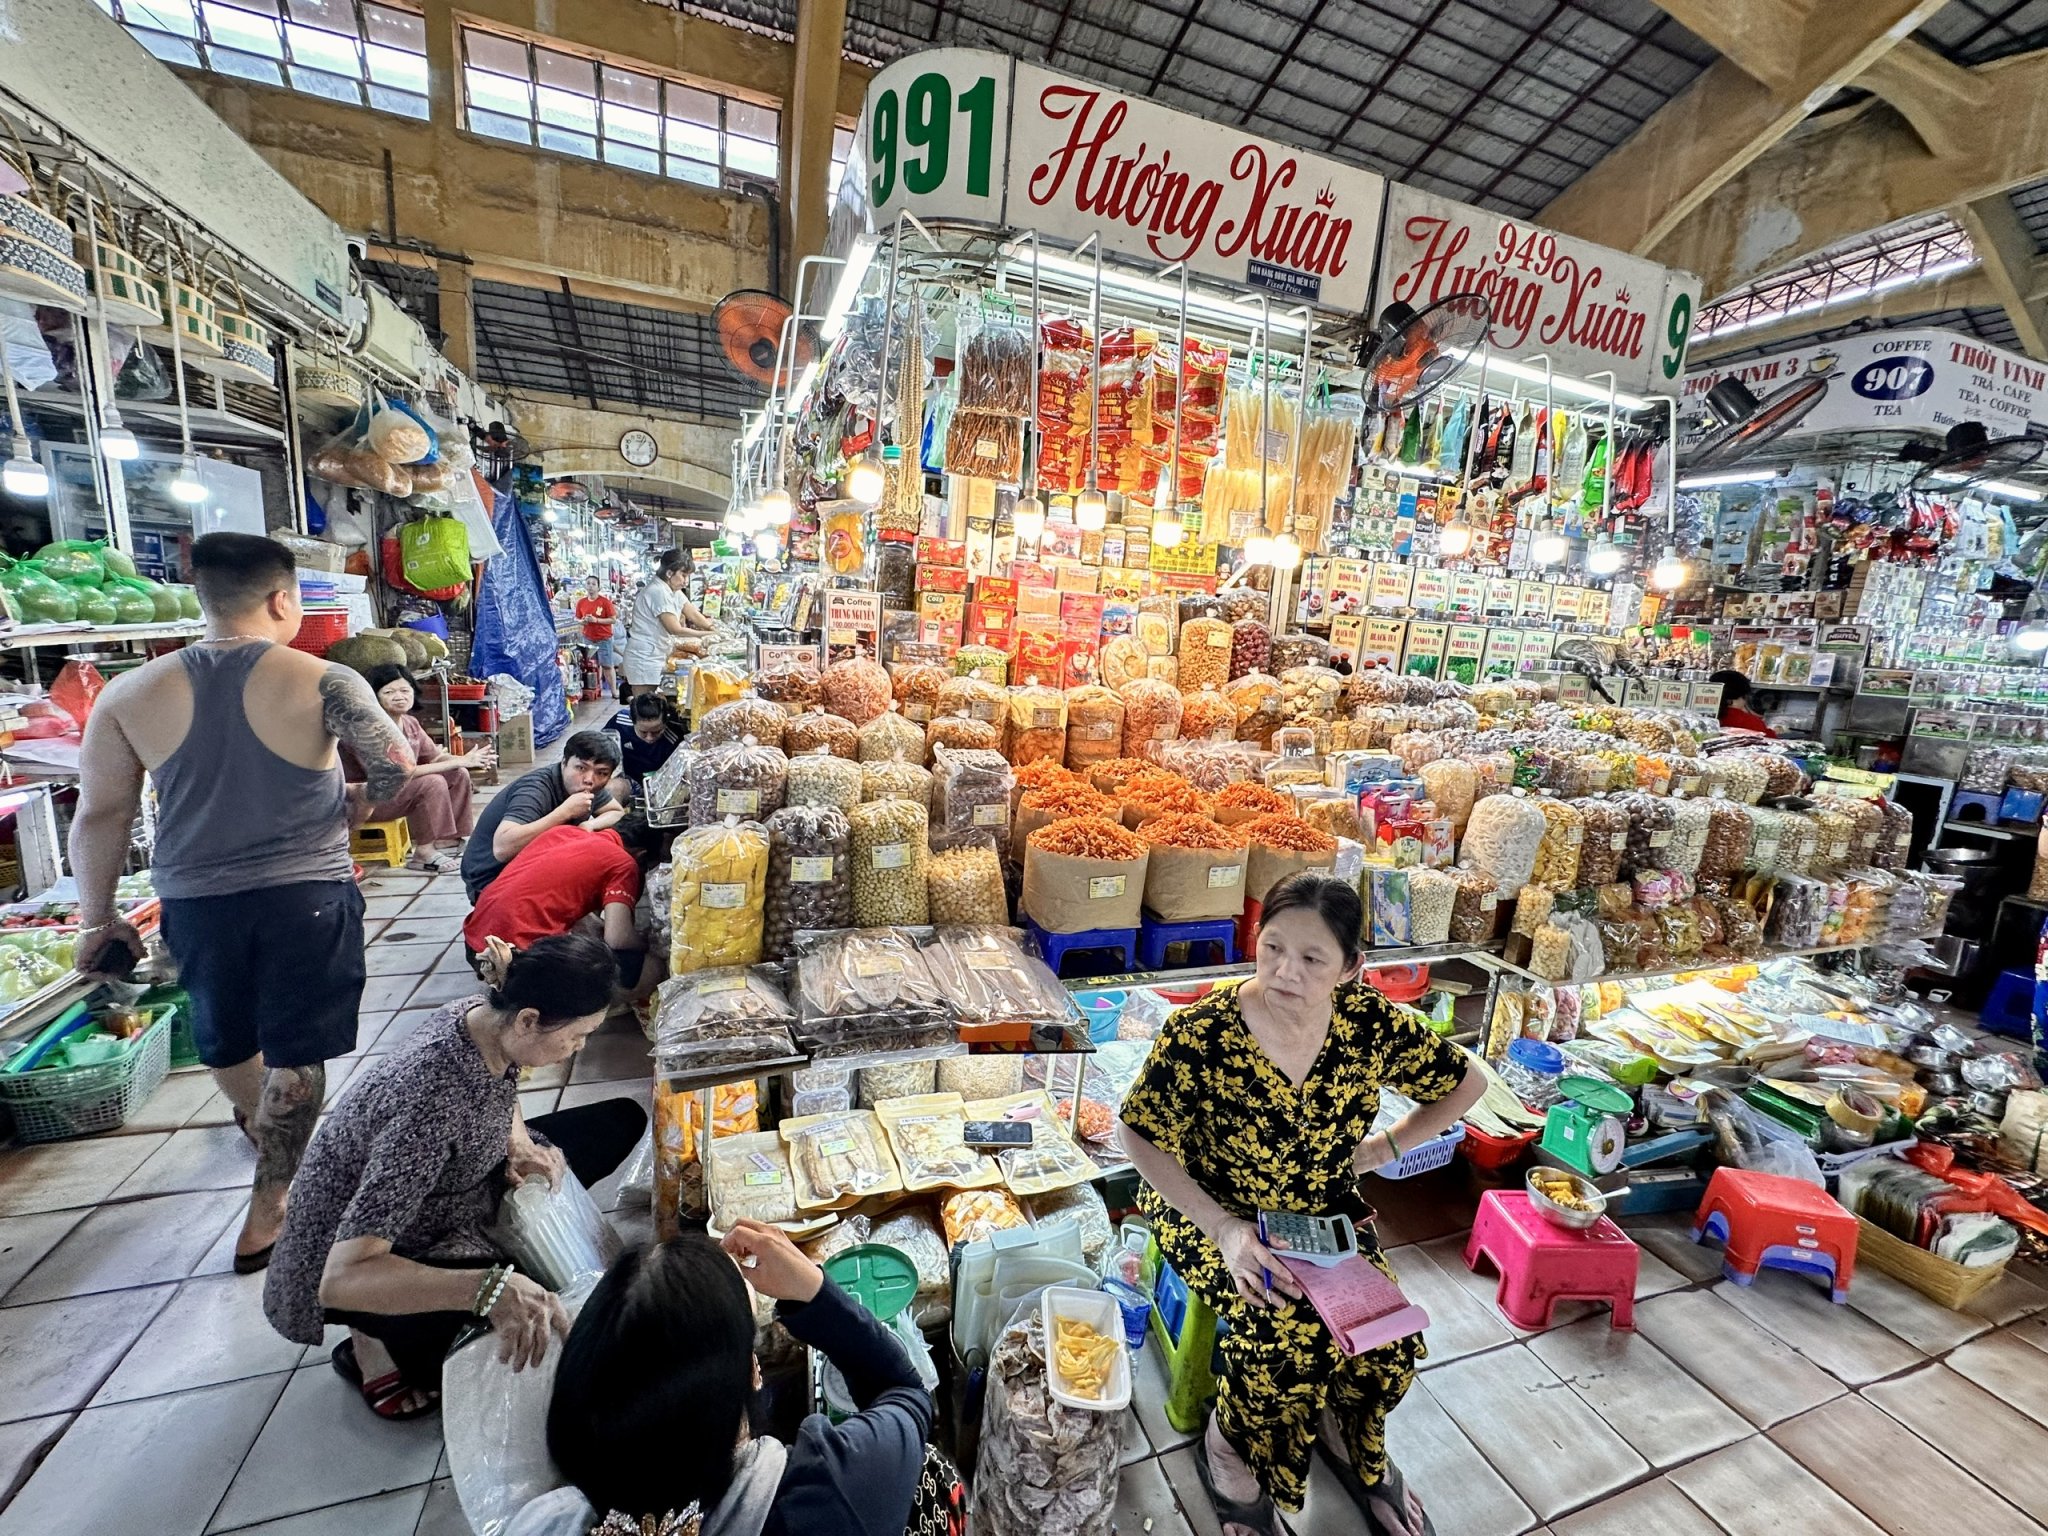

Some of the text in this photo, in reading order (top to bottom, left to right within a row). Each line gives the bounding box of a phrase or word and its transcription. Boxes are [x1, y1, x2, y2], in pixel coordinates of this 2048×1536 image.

[872, 73, 995, 208] 991
[1028, 85, 1224, 262] Hương
[1494, 222, 1556, 277] 949
[1265, 278, 1302, 294] Fixed Price
[1393, 216, 1543, 350] Hương
[1663, 293, 1690, 380] 9
[1873, 340, 1932, 354] COFFEE
[1785, 357, 1798, 376] 3
[2004, 360, 2046, 391] VINH
[1864, 366, 1928, 391] 907
[1959, 389, 1981, 405] TEA
[2003, 385, 2032, 403] CAFE
[1874, 405, 1903, 416] TEA
[847, 597, 872, 607] Coffee
[831, 608, 851, 620] TRUNG
[1452, 640, 1480, 650] GREEN TEA
